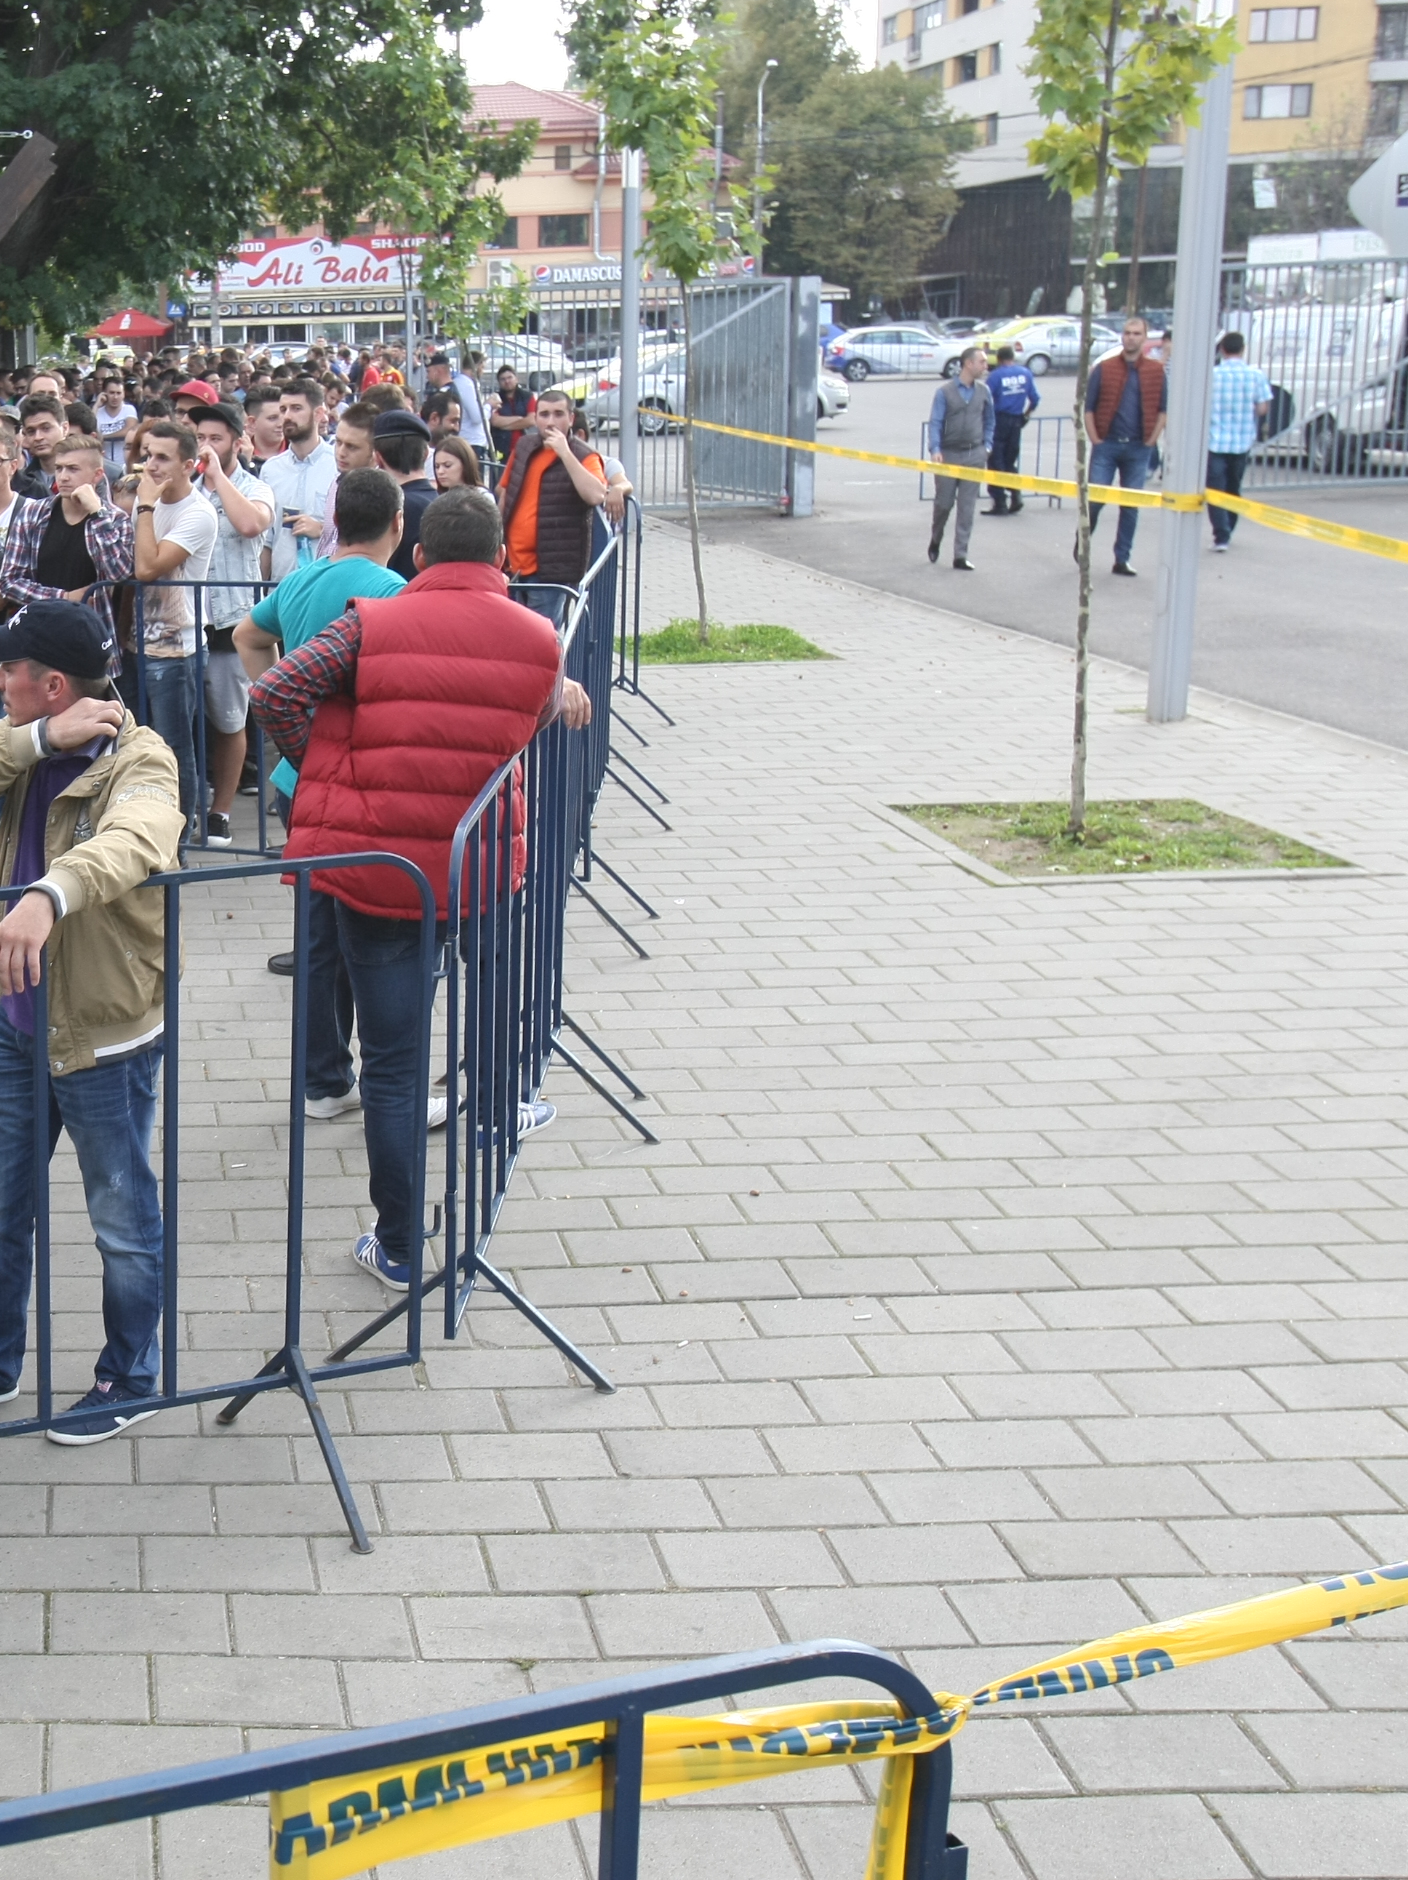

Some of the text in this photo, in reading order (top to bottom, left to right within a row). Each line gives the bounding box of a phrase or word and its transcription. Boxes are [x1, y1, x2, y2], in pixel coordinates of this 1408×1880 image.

[247, 255, 390, 288] Ali Baba
[552, 265, 623, 284] DAMASCUS
